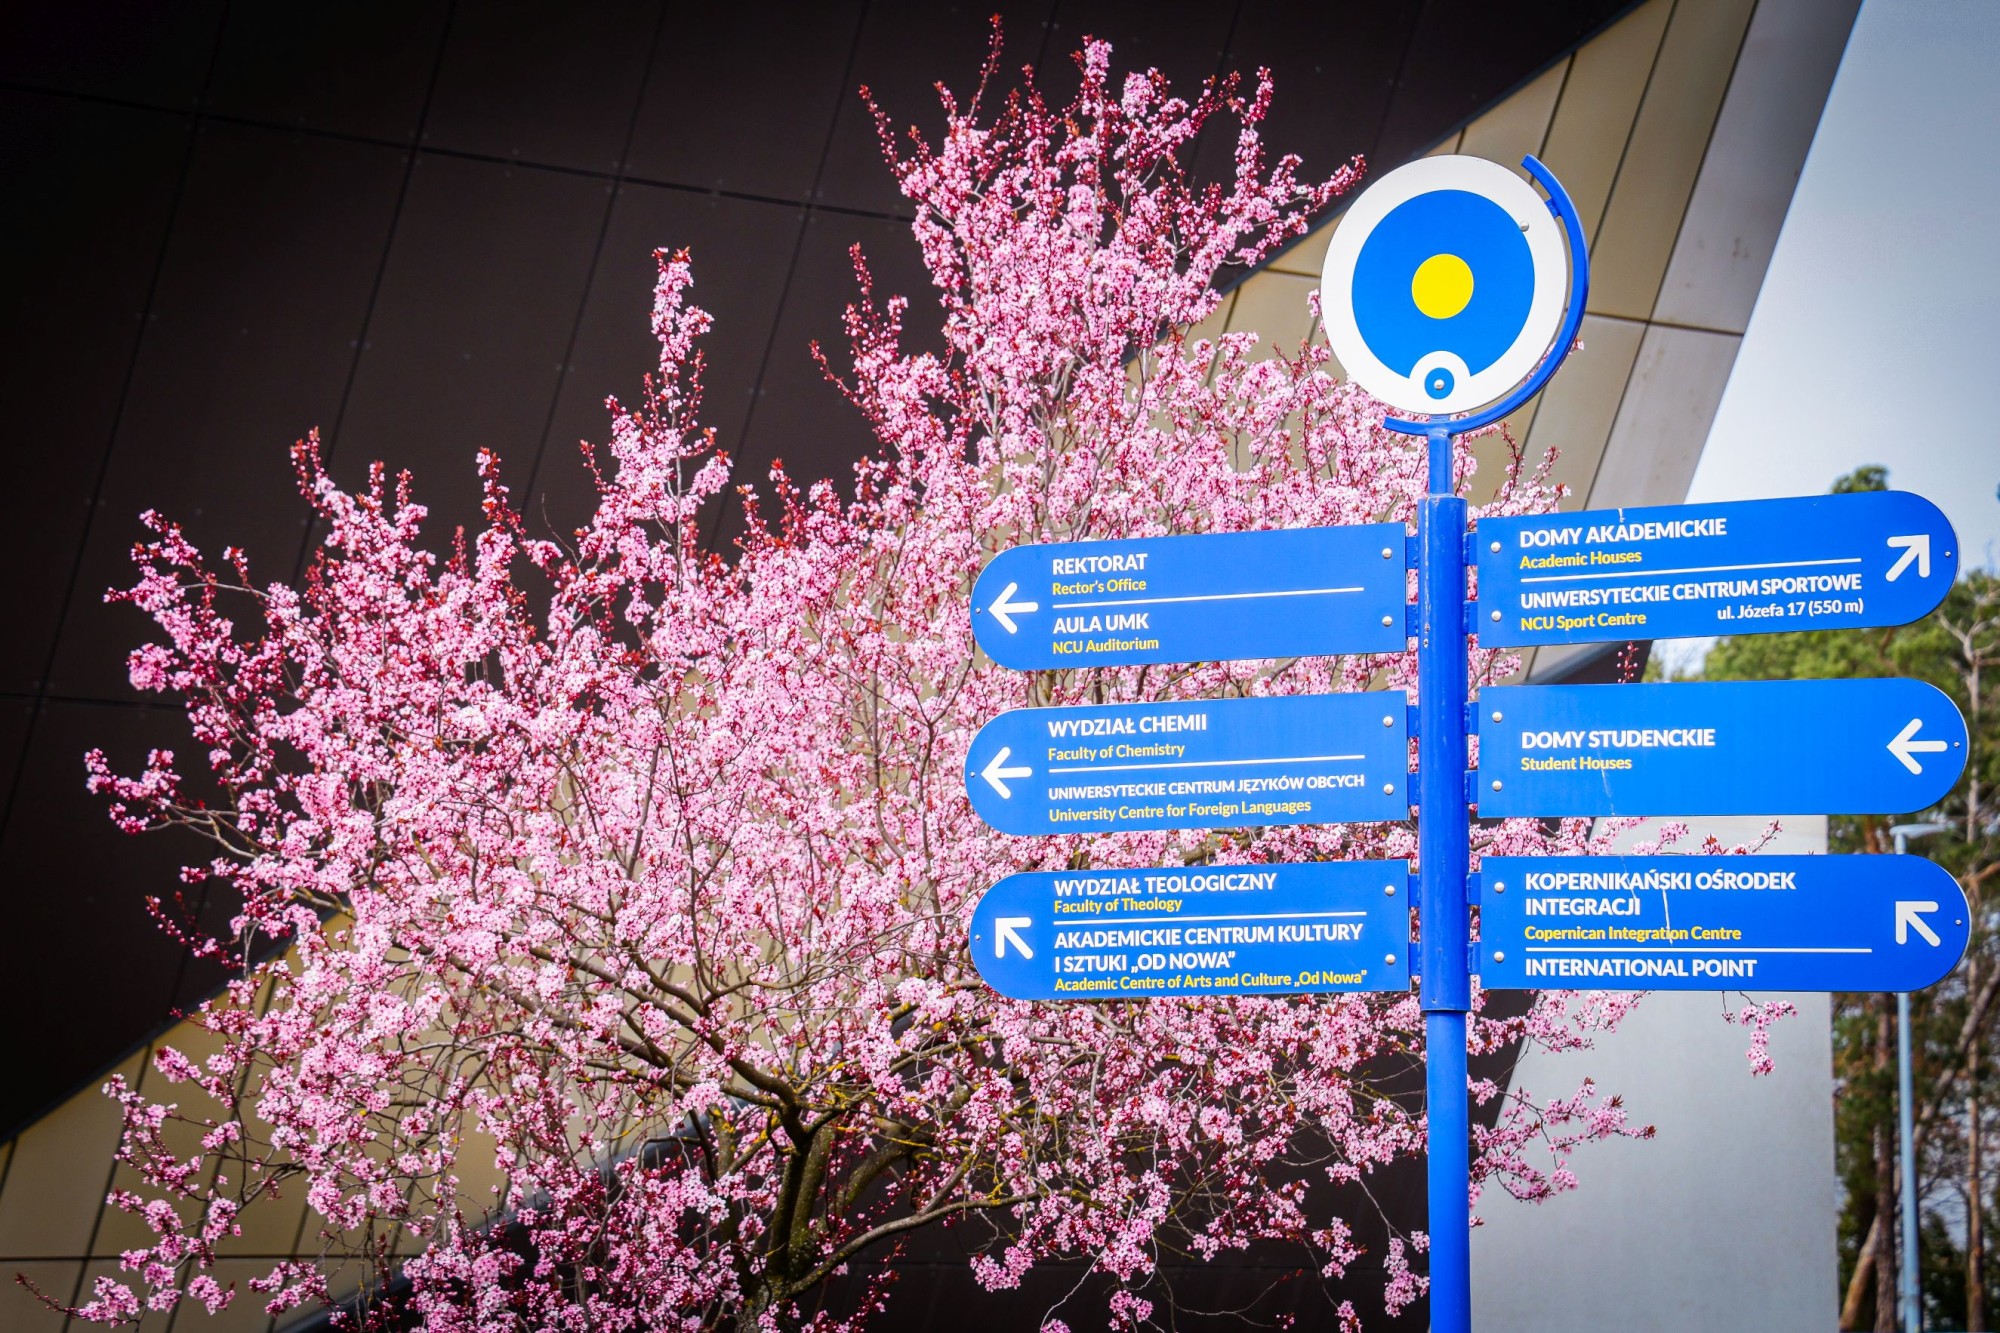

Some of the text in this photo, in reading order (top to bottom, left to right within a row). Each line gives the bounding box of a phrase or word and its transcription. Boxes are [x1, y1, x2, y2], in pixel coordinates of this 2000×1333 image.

[1520, 518, 1727, 548] DOMY AKADEMICKIE
[1053, 553, 1148, 575] REKTORAT
[1520, 551, 1642, 569] Academic Houses
[1106, 578, 1146, 592] Office
[1521, 574, 1862, 609] UNIWERSYTECKIE CENTRUM SPORTOWE
[1718, 598, 1863, 619] ul. Józefa 17 (550 m)
[1053, 613, 1149, 634] AULA UMK
[1521, 613, 1646, 631] NCU Sport Centre
[1053, 637, 1159, 654] NCU Auditorium
[1048, 714, 1207, 738] WYDZIAŁ CHEMII
[1522, 729, 1715, 749] DOMY STUDENCKIE
[1048, 743, 1185, 761] Faculty of Chemistry
[1521, 757, 1632, 770] Student Houses
[1048, 774, 1365, 800] UNIWERSYTECKIE CENTRUM JĘZYKÓW OBCYCH
[1049, 801, 1311, 822] University Centre for Foreign Languages
[1054, 873, 1277, 896] WYDZIAŁ TEOLOGICZNY
[1526, 869, 1796, 889] KOPERNIKAŃSKI OŚRODEK
[1055, 897, 1182, 914] Faculty of Theology
[1526, 897, 1640, 915] INTEGRACJI
[1055, 924, 1363, 948] AKADEMICKIE CENTRUM KULTURY
[1525, 926, 1741, 942] Copernican Integration Centre
[1055, 957, 1060, 972] I
[1064, 955, 1127, 972] SZTUKI
[1526, 959, 1757, 976] INTERNATIONAL POINT
[1055, 977, 1117, 991] Academic
[1120, 977, 1165, 989] Centre
[1167, 975, 1183, 988] of
[1184, 975, 1212, 987] Arts
[1214, 973, 1238, 987] and
[1241, 973, 1291, 986] Culture
